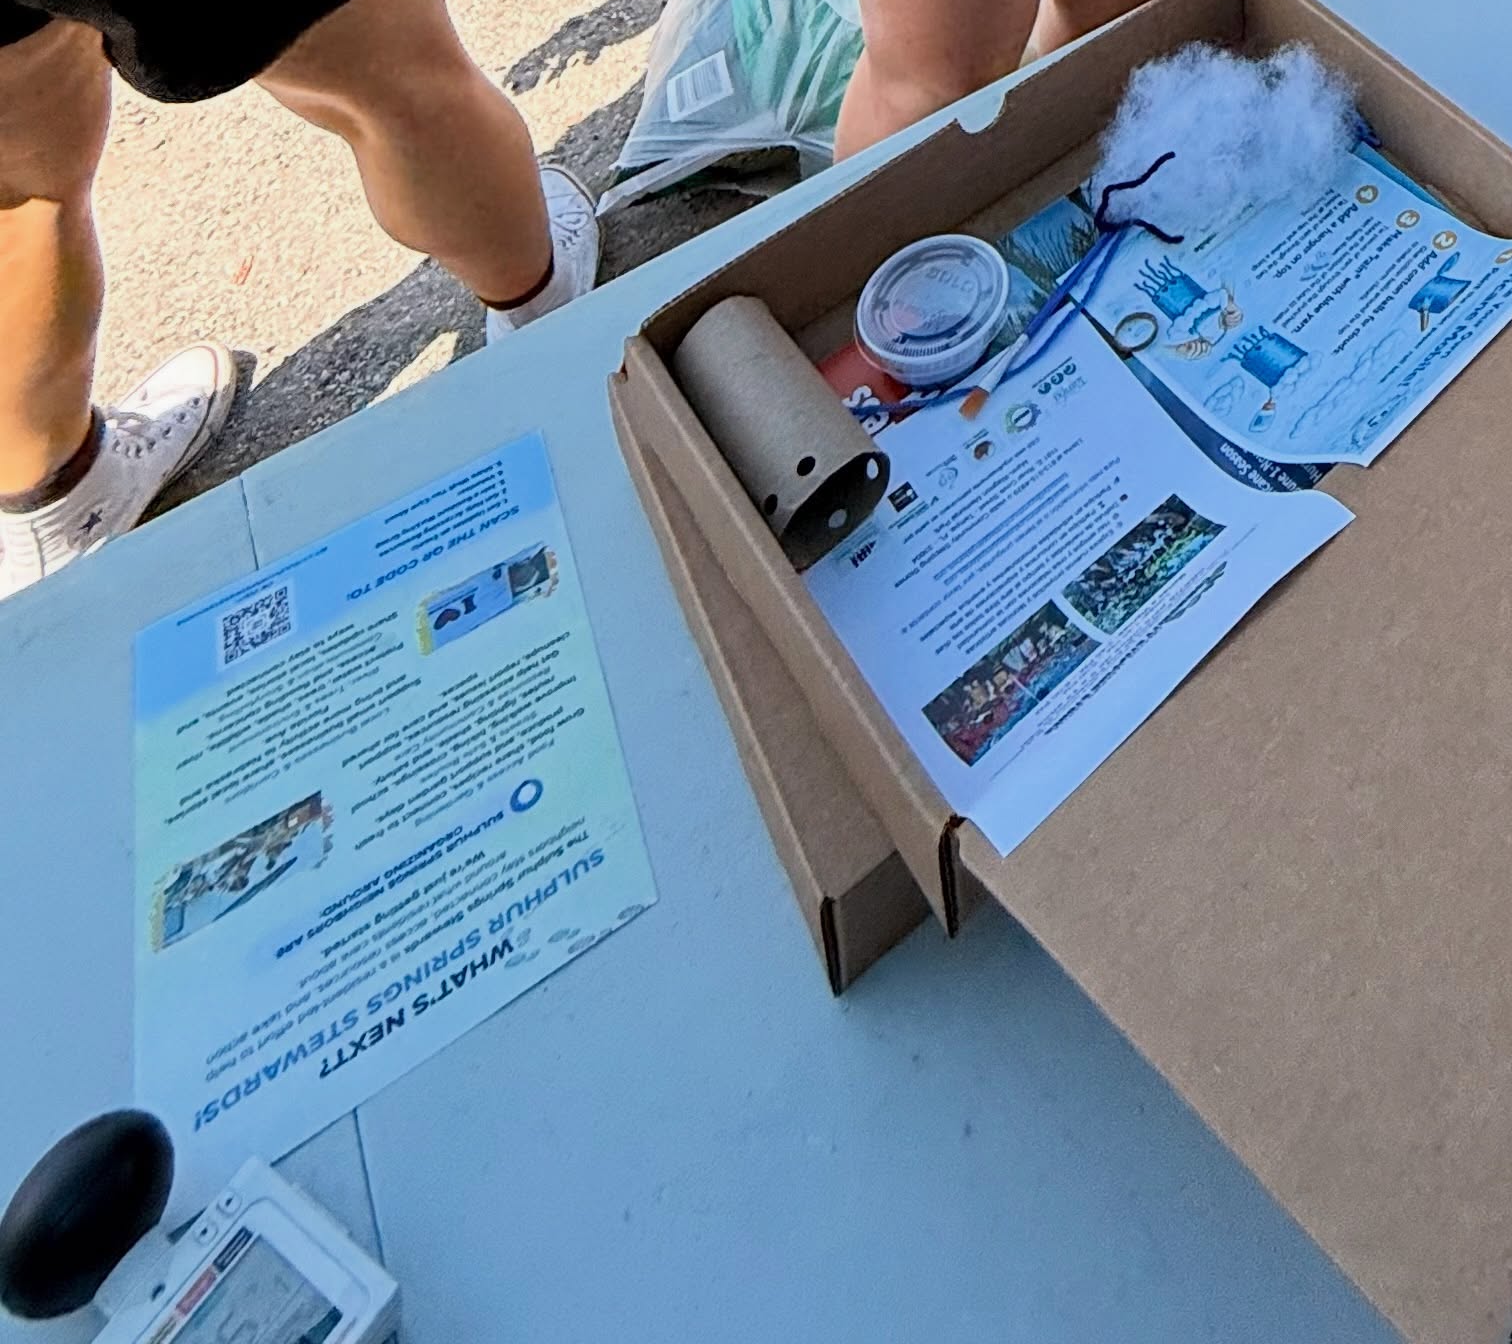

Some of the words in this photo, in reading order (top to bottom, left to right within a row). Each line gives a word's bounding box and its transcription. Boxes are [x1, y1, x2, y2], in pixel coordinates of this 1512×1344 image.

[1329, 219, 1339, 229] a
[1335, 201, 1360, 224] Add
[1397, 209, 1418, 230] 3
[1299, 224, 1333, 256] hanger
[1374, 227, 1403, 255] Make
[1433, 228, 1455, 251] 2
[1270, 260, 1293, 283] top.
[1288, 251, 1304, 266] on
[1350, 250, 1381, 281] "rain"
[1416, 248, 1438, 271] Add
[1330, 275, 1354, 298] with
[1391, 267, 1420, 297] cotton
[1312, 293, 1335, 316] blue
[1371, 293, 1394, 316] balls
[1288, 310, 1316, 337] yarn.
[1359, 312, 1375, 329] for
[1330, 325, 1362, 357] clouds.
[1396, 320, 1467, 392] Mobile!
[448, 847, 486, 880] We're
[422, 869, 448, 897] just
[486, 844, 605, 937] SULPHUR
[373, 888, 421, 928] getting
[319, 919, 371, 962] started.
[364, 925, 482, 1018] SPRINGS
[410, 934, 514, 1019] WHAT'S
[317, 1005, 406, 1081] NEXT?
[192, 1005, 359, 1134] STEWARDS!
